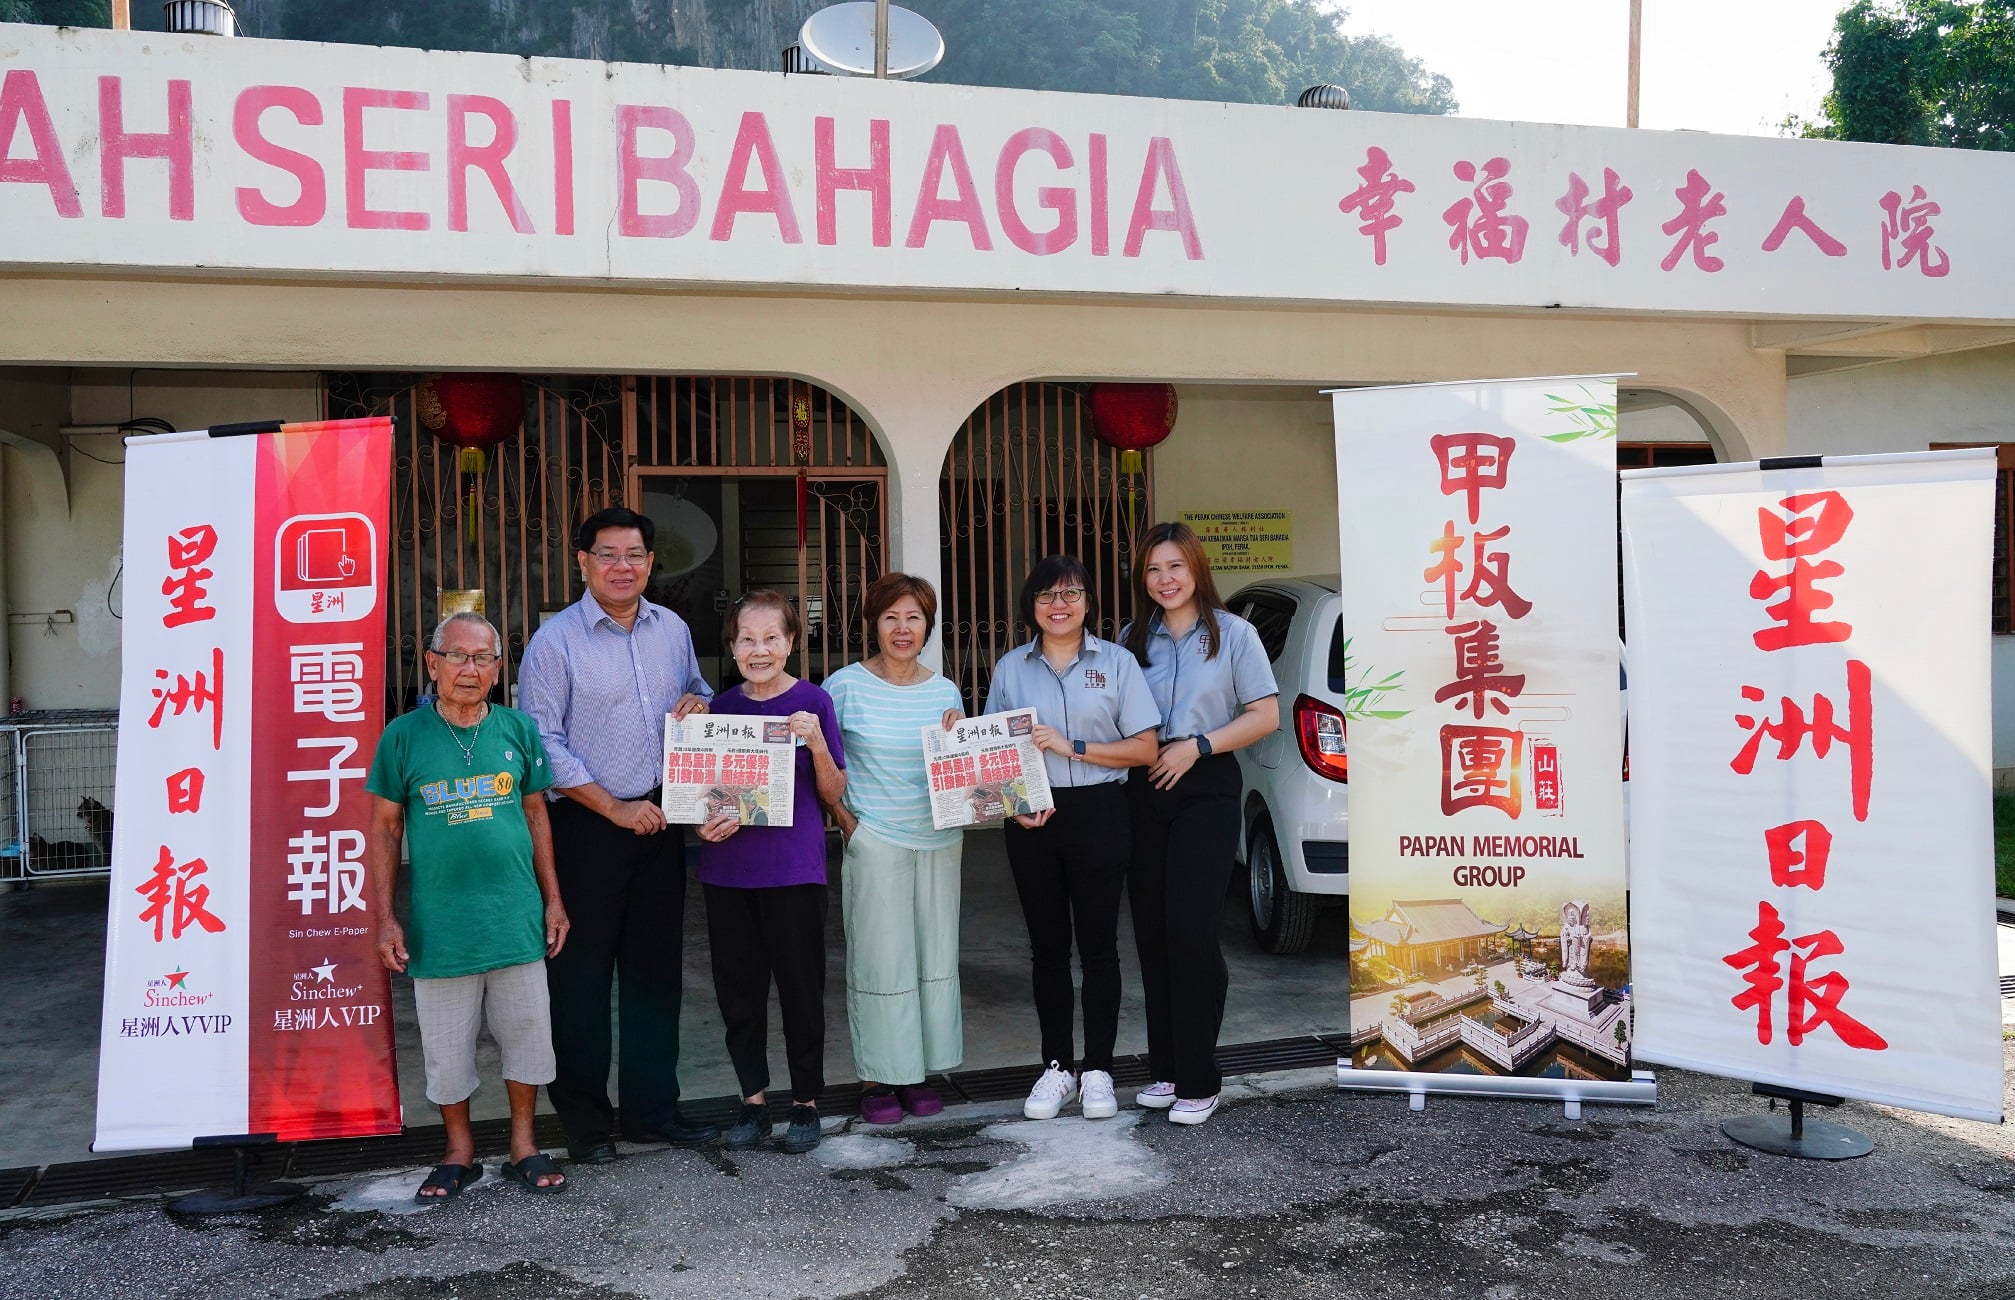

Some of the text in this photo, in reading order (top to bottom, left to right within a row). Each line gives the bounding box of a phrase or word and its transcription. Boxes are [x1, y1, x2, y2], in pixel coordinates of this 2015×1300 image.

[233, 85, 574, 235] SERI
[616, 104, 1205, 260] BAHAGIA
[1338, 145, 1951, 278] 幸福村老人院
[311, 591, 344, 614] 星洲
[1424, 432, 1533, 821] 甲板集團
[135, 524, 226, 942] 星洲日報
[287, 642, 367, 916] 電子報
[420, 774, 496, 805] BLUE
[1538, 754, 1556, 801] 山莊
[1721, 490, 1889, 1050] 星洲日報
[1399, 835, 1584, 859] PAPAN MEMORIAL
[1453, 865, 1526, 888] GROUP
[288, 927, 369, 939] Sin Chew E-Paper
[119, 1015, 232, 1038] 星洲人VVIP
[272, 1005, 381, 1032] 星洲人VIP
